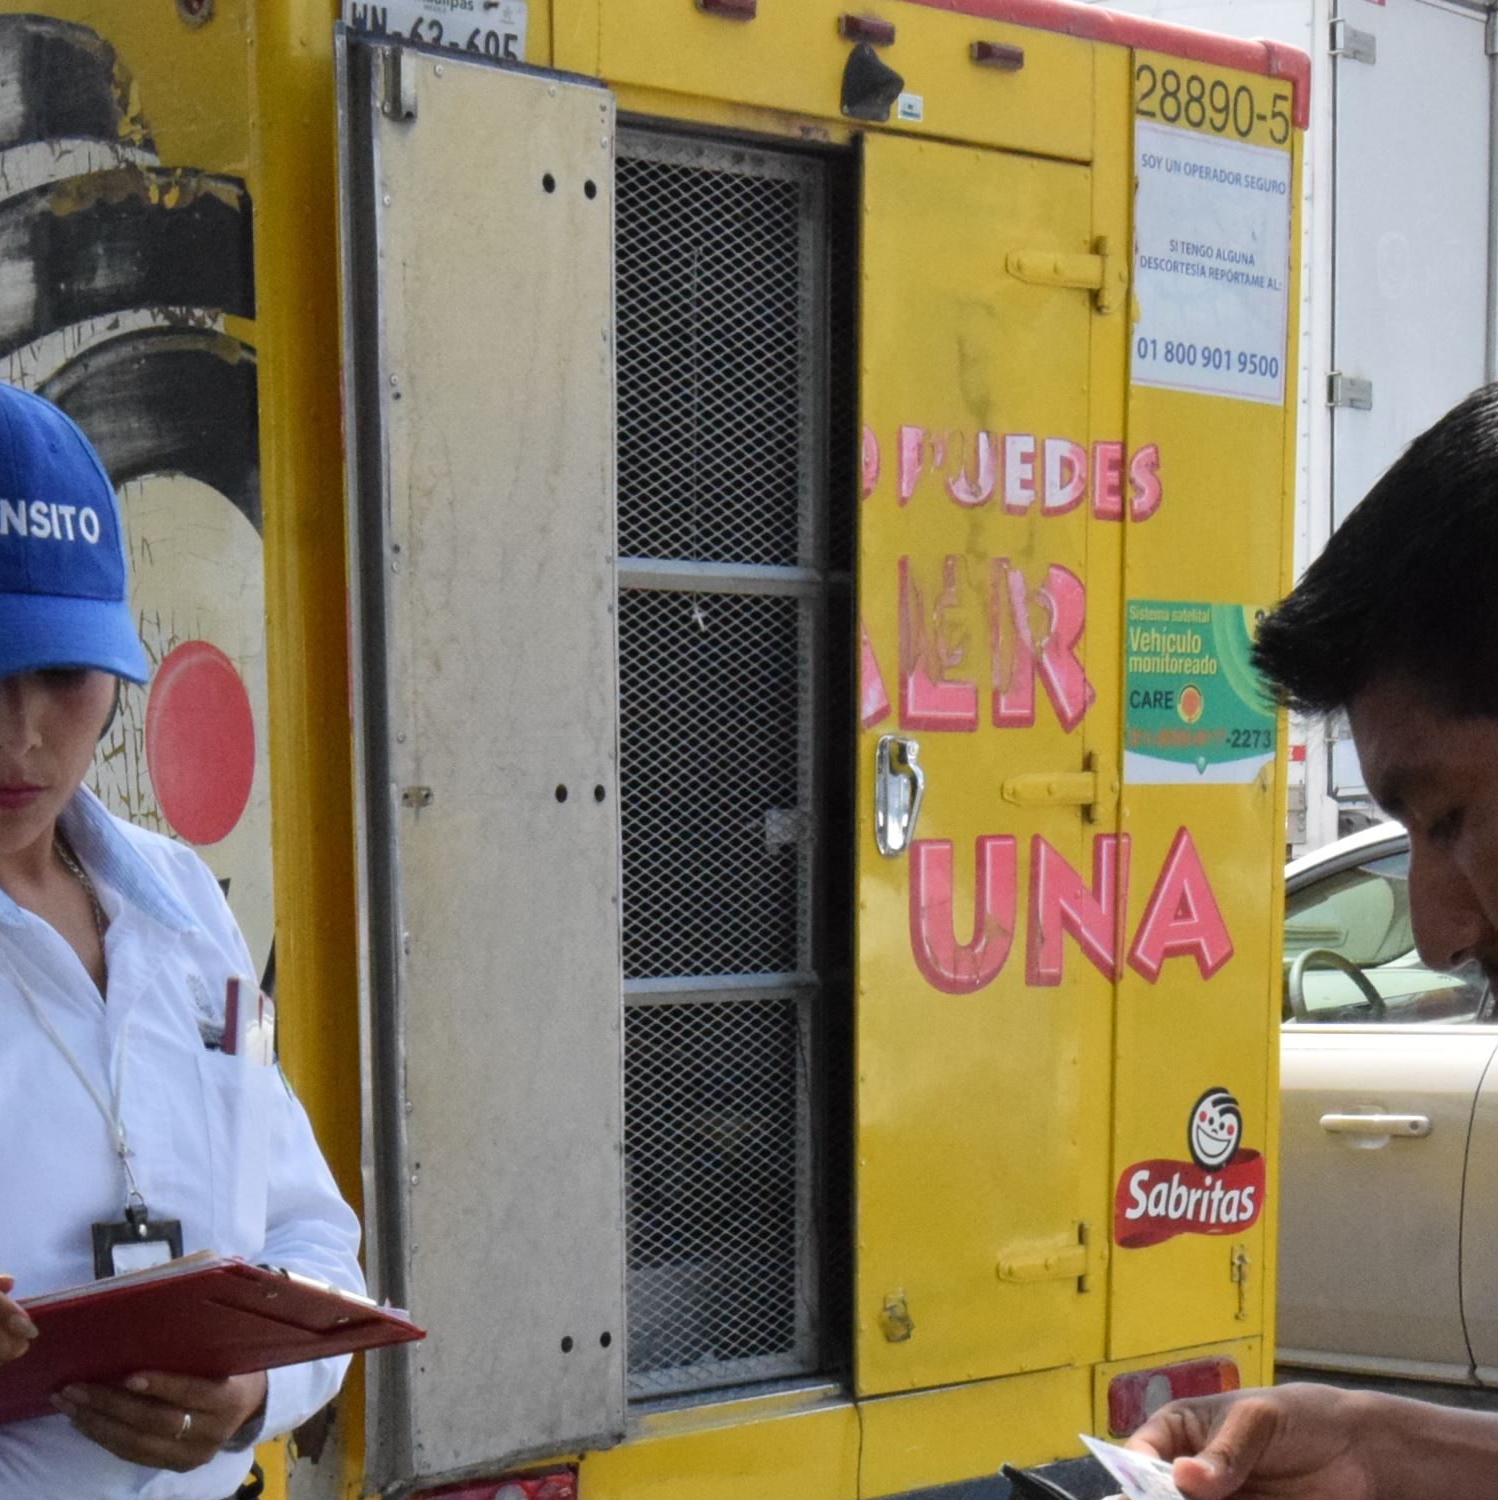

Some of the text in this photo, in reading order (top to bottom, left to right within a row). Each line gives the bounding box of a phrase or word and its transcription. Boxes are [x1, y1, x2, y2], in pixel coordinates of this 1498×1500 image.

[1135, 64, 1290, 145] 28890-5
[1141, 153, 1286, 196] SOY UN OPERADOR SEGURO
[1140, 255, 1207, 278] DESCORTESÍA
[1169, 239, 1256, 267] SI TENGO ALGUNA
[1137, 337, 1279, 379] 01 800 901 9500
[1129, 606, 1211, 624] Sistema satelital
[1129, 626, 1201, 653] Vehículo
[1129, 654, 1218, 675] monitoreado
[1129, 690, 1174, 709] CARE
[908, 826, 1234, 995] UNA
[1125, 1169, 1255, 1225] Sabritas
